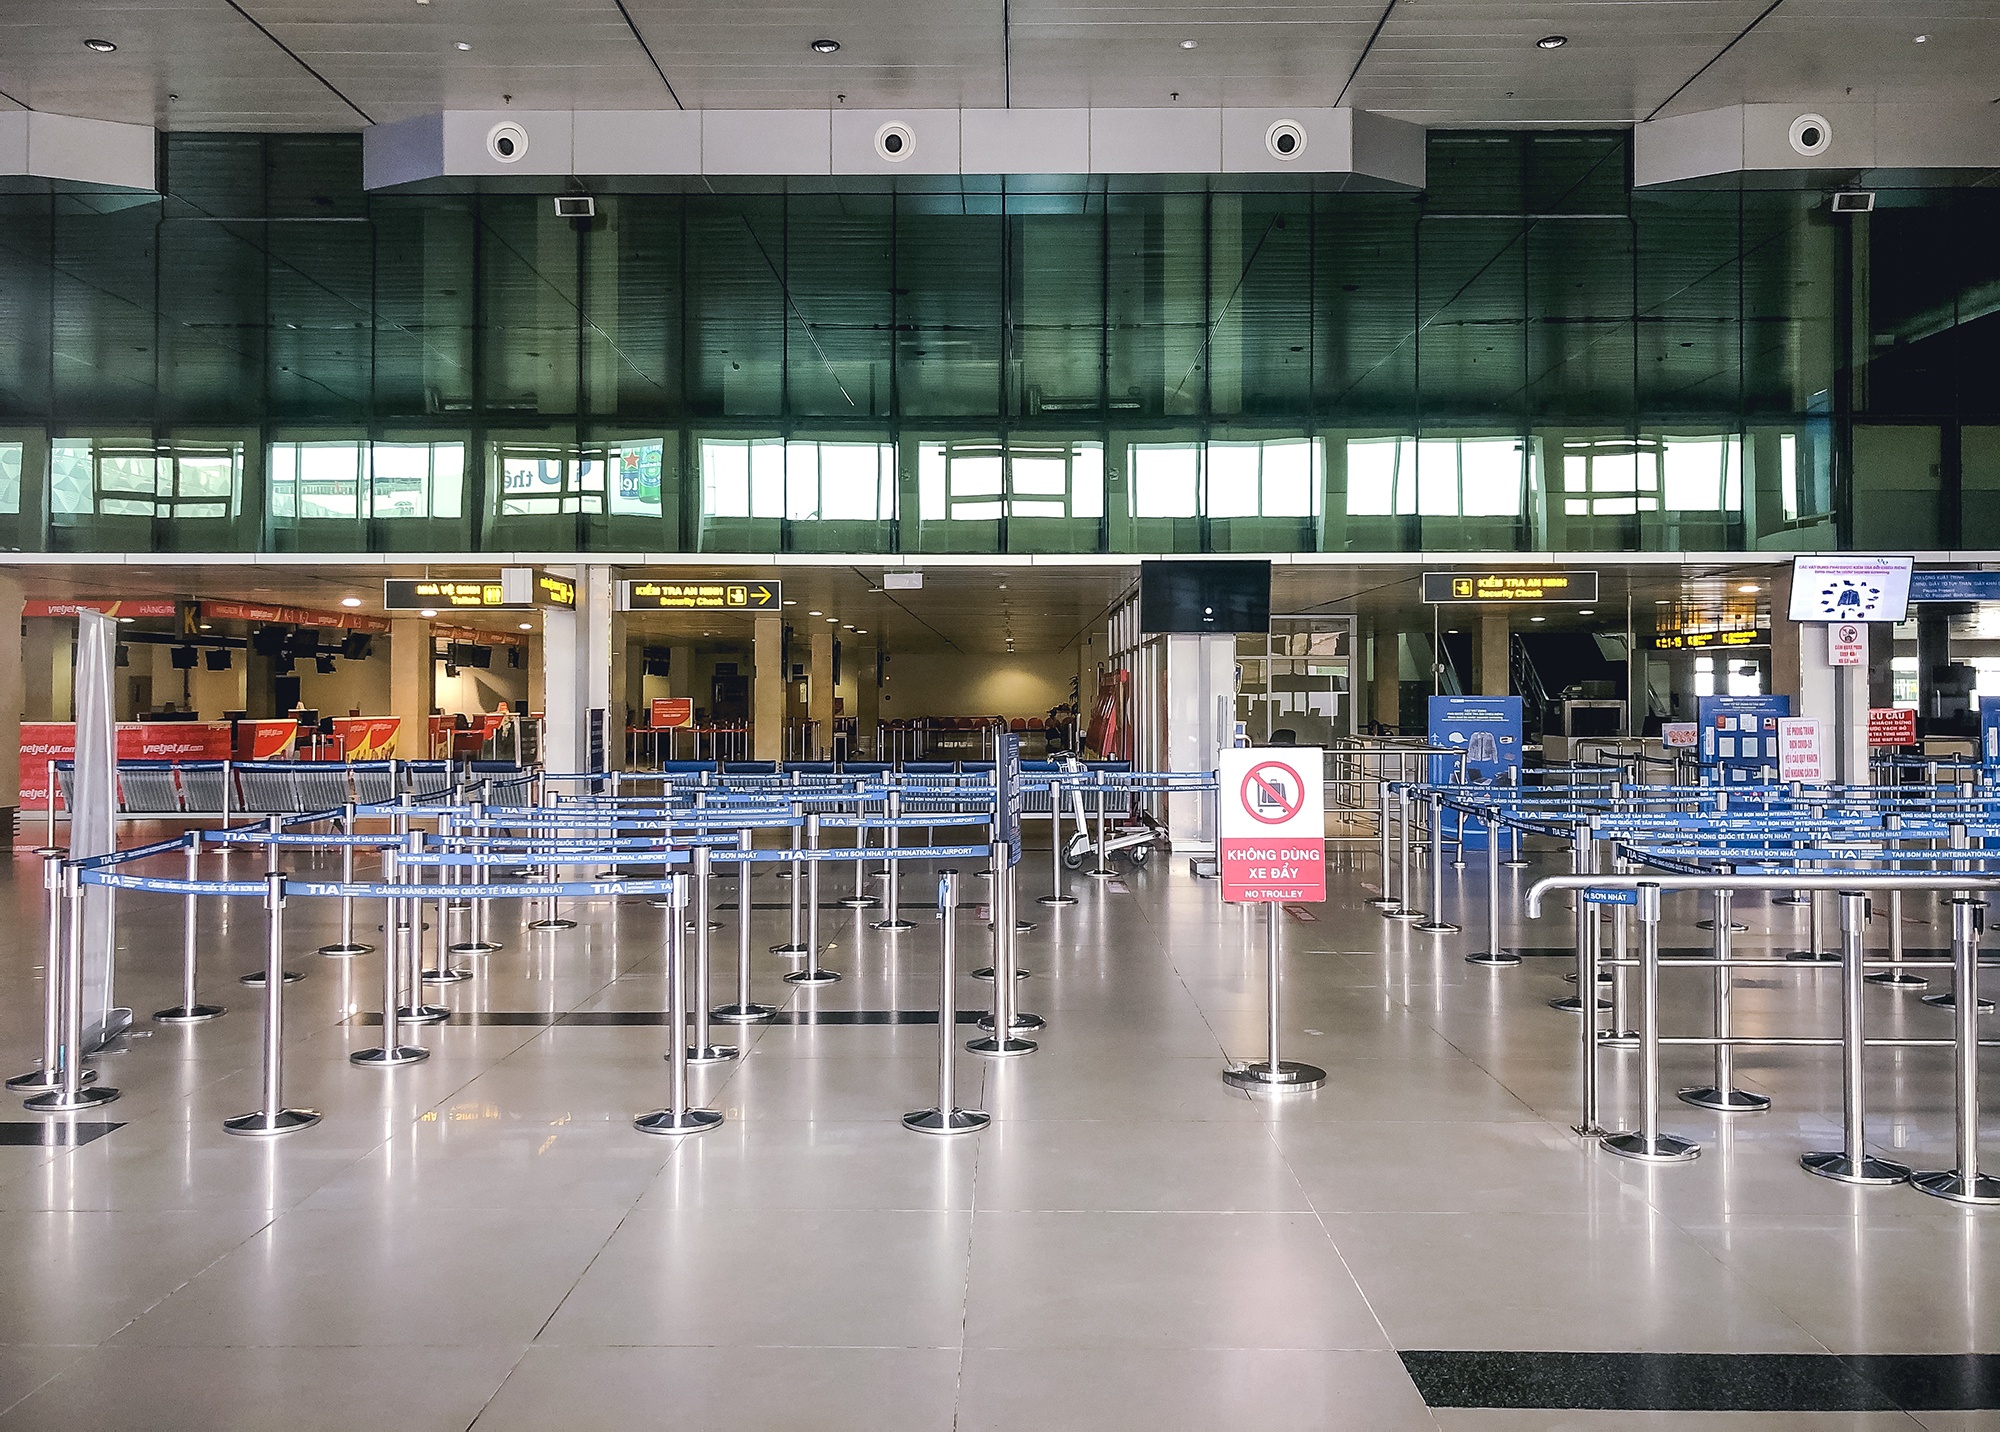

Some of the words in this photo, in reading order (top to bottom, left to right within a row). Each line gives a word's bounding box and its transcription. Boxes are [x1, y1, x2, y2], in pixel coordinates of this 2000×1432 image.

[1505, 578, 1526, 588] TRA
[1527, 578, 1541, 588] AN
[662, 587, 682, 596] TRA
[683, 587, 698, 596] AN
[1478, 590, 1514, 599] Security
[660, 597, 696, 607] Security
[184, 606, 197, 634] K
[223, 832, 248, 841] TIA
[1657, 831, 1675, 839] CẢNG
[1695, 832, 1717, 840] KHÔNG
[1718, 832, 1736, 840] QUỐC
[1737, 832, 1745, 840] TẾ
[1746, 832, 1759, 840] TÂN
[1774, 832, 1791, 840] NHẤT
[1808, 832, 1832, 840] TIA
[441, 837, 466, 845] TIA
[721, 851, 736, 859] SƠN
[737, 851, 757, 859] NHẤT
[777, 851, 805, 860] TIA
[887, 849, 941, 857] INTERNATIONAL
[1227, 847, 1276, 860] KHÔNG
[1281, 846, 1320, 861] DÙNG
[1626, 850, 1637, 860] TIA
[1657, 846, 1675, 854] CẢNG
[1696, 847, 1719, 856] KHÔNG
[1720, 848, 1739, 857] QUỐC
[1740, 848, 1748, 856] TẾ
[1749, 849, 1763, 857] TÂN
[1778, 849, 1798, 857] NHẤT
[1828, 850, 1859, 859] TIA
[1941, 850, 1993, 858] INTERNATIONAL
[473, 855, 499, 863] TIA
[1249, 868, 1266, 879] XE
[1271, 862, 1299, 879] ĐẨY
[99, 874, 120, 885] TIA
[307, 884, 339, 895] TIA
[376, 885, 400, 895] CẢNG
[402, 885, 427, 895] HÀNG
[428, 886, 459, 895] KHÔNG
[461, 884, 486, 896] QUỐC
[488, 885, 499, 895] TẾ
[501, 885, 517, 895] TÂN
[519, 885, 538, 895] SƠN
[540, 884, 564, 895] NHẤT
[591, 884, 625, 894] TIA
[1245, 890, 1258, 898] NO
[1261, 890, 1303, 898] TROLLEY
[1590, 891, 1605, 900] SƠN
[1606, 891, 1627, 901] NHẤT
